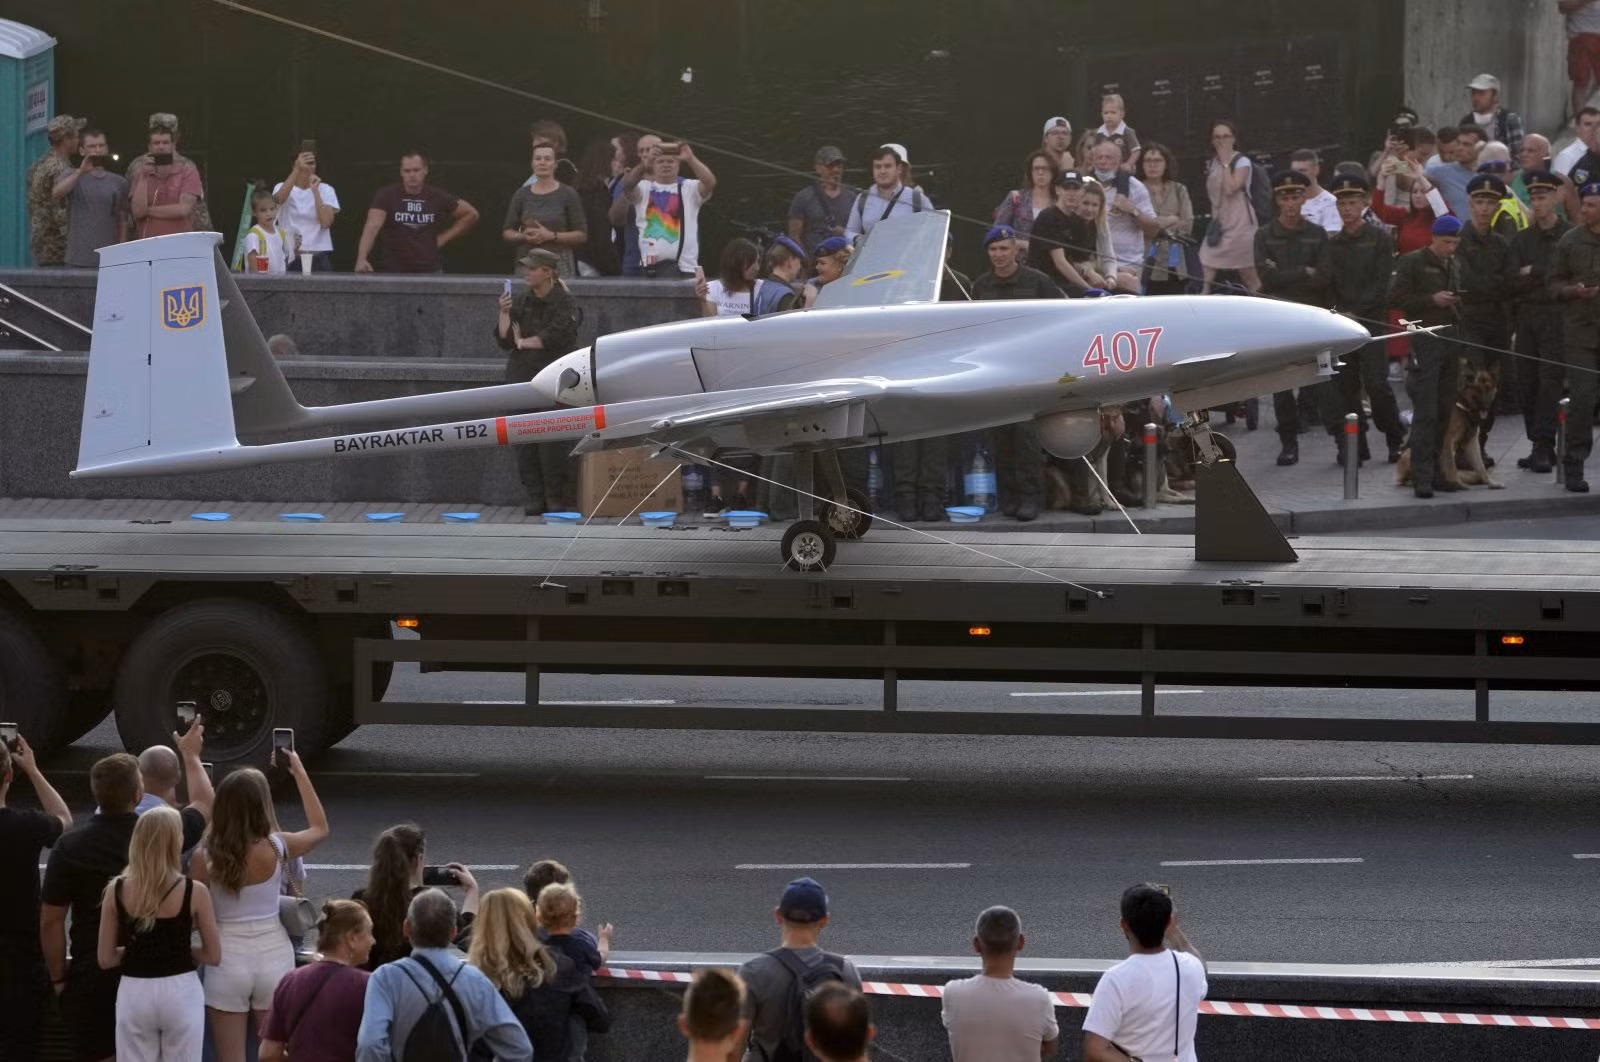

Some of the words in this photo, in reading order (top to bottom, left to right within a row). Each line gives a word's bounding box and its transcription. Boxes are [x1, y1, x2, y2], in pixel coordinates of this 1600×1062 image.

[407, 202, 422, 212] BIG
[394, 212, 415, 222] CITY
[417, 213, 436, 224] LIFE
[717, 302, 751, 310] WARNIN
[1082, 326, 1164, 376] 407
[508, 417, 555, 428] НЕБЕЗПЕЧНО
[518, 426, 546, 435] DANGER
[547, 423, 586, 433] PROPELLER
[334, 428, 444, 453] BAYRAKTAR
[454, 423, 488, 440] TB2
